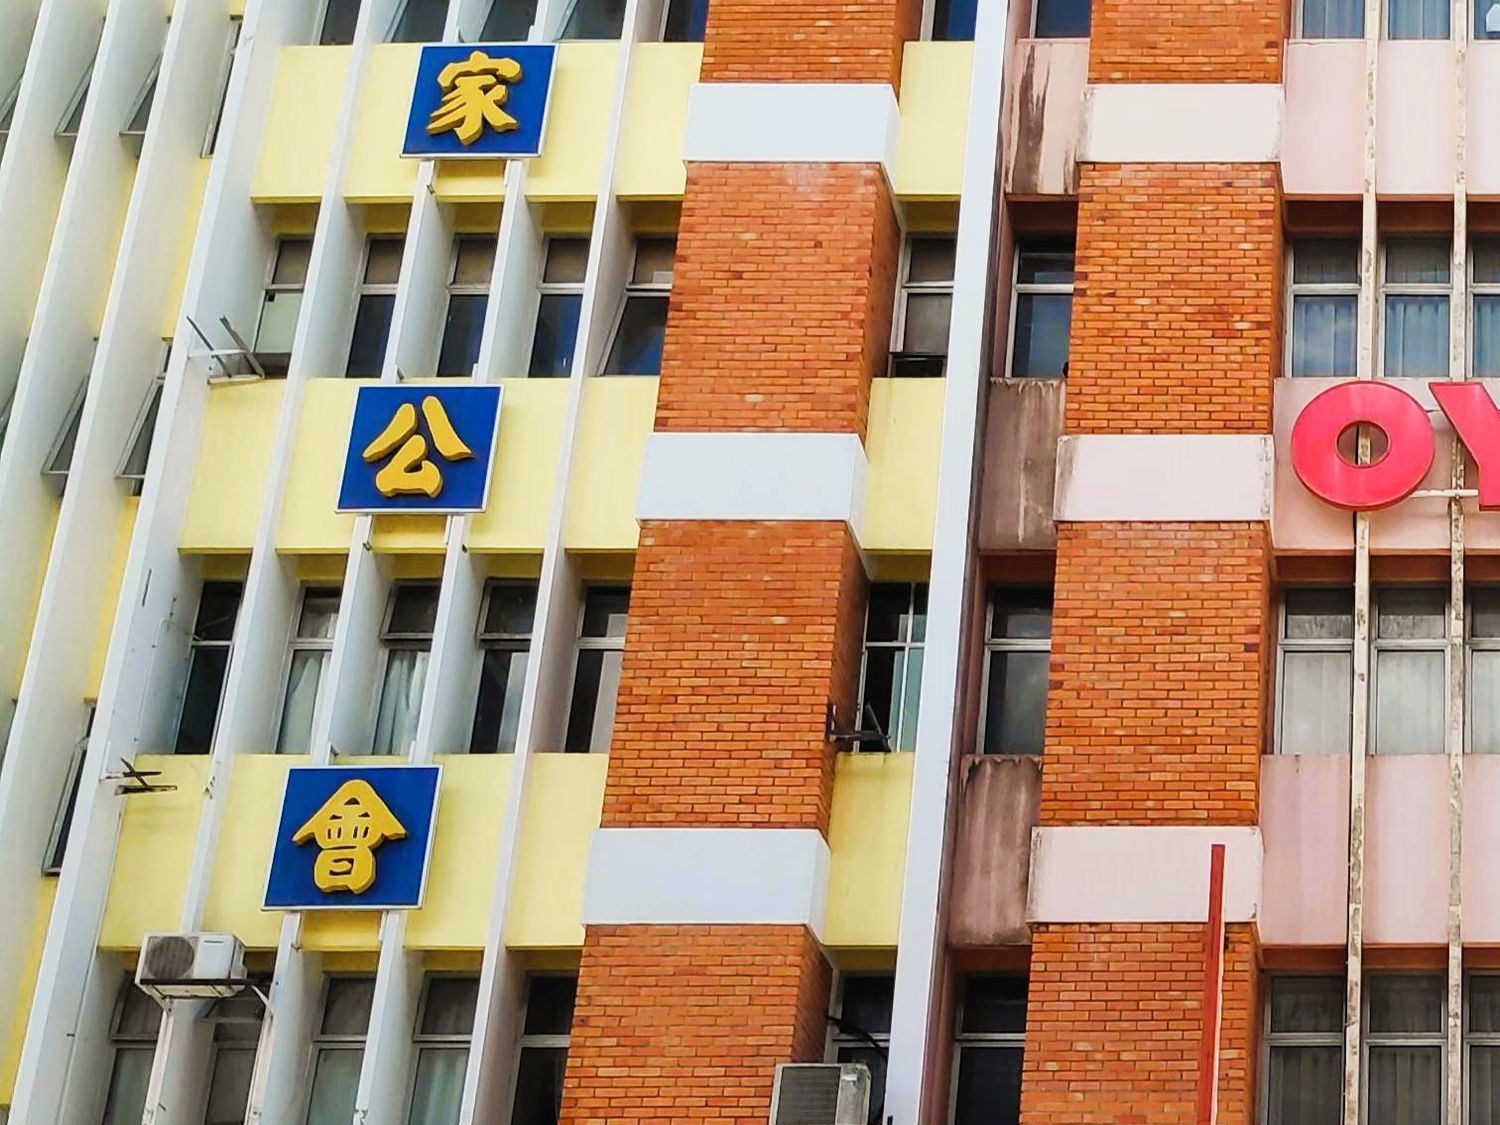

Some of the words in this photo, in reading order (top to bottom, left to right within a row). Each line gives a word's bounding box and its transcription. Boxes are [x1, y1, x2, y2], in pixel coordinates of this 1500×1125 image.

[426, 51, 523, 145] 家
[363, 394, 474, 499] 公
[291, 777, 409, 894] 會
